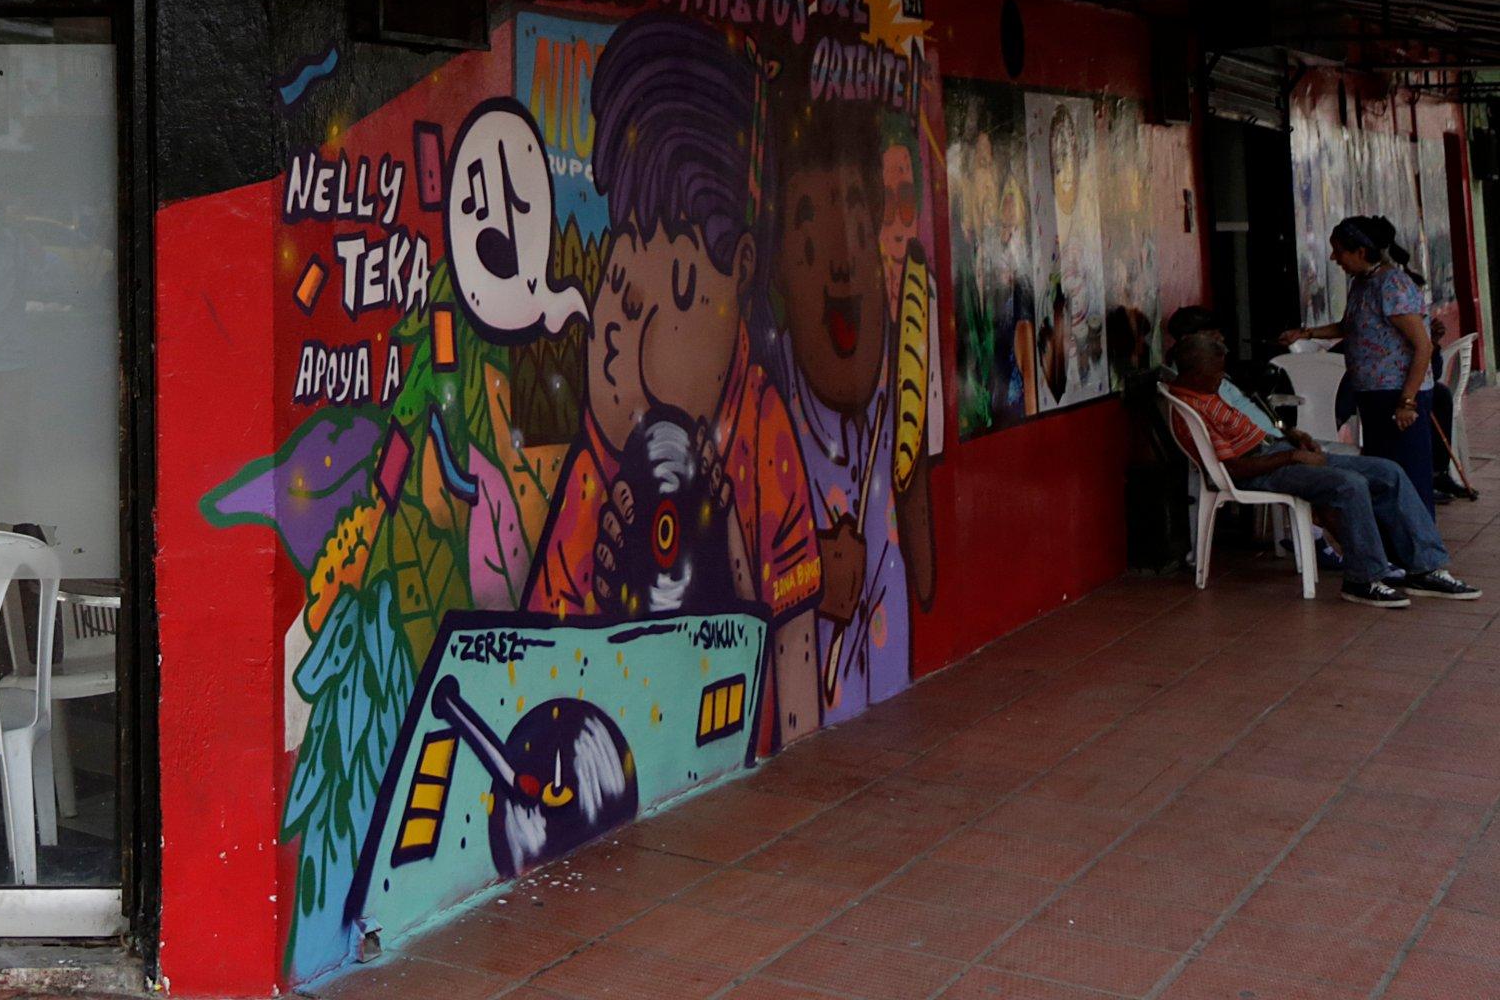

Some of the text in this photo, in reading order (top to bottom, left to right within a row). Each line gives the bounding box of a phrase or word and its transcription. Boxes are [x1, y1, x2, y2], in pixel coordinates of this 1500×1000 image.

[285, 151, 404, 226] NELLY
[336, 231, 432, 314] TEKA
[294, 344, 401, 403] APOYA A
[457, 630, 526, 664] ZEREZ
